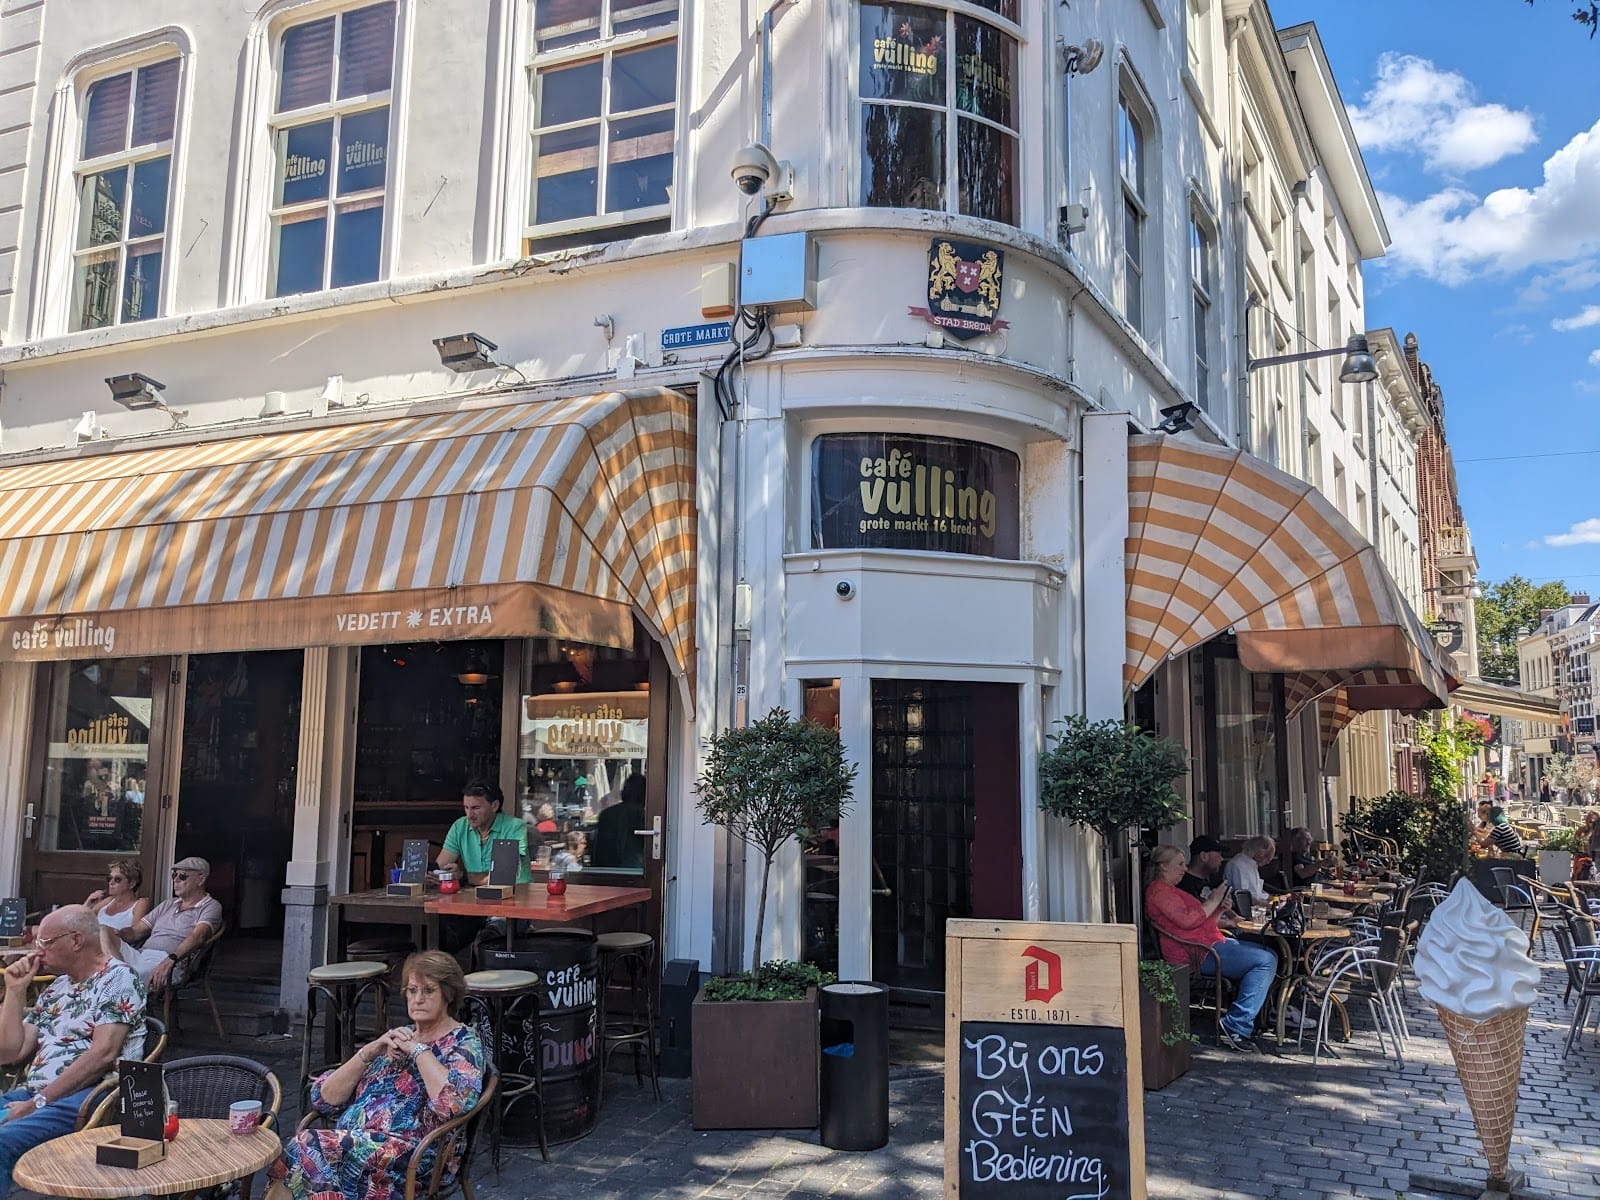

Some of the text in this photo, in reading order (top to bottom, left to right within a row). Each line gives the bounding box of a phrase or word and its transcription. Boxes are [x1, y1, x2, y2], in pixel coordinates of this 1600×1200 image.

[874, 36, 896, 49] café
[874, 43, 937, 75] vulling
[285, 154, 299, 165] afé
[663, 326, 730, 345] GROTE MARKT
[933, 316, 991, 332] STAD BREDA
[860, 448, 913, 478] café
[860, 464, 996, 538] vulling
[859, 517, 977, 536] grote markt 16 breda
[336, 605, 492, 632] VEDETT EXTRA
[12, 619, 116, 653] café vulling
[737, 686, 746, 694] 25
[546, 963, 580, 986] café
[548, 977, 597, 1009] vulling
[1011, 1008, 1070, 1022] ESTD. 1871
[1038, 1044, 1104, 1075] ons
[123, 1074, 148, 1102] Please
